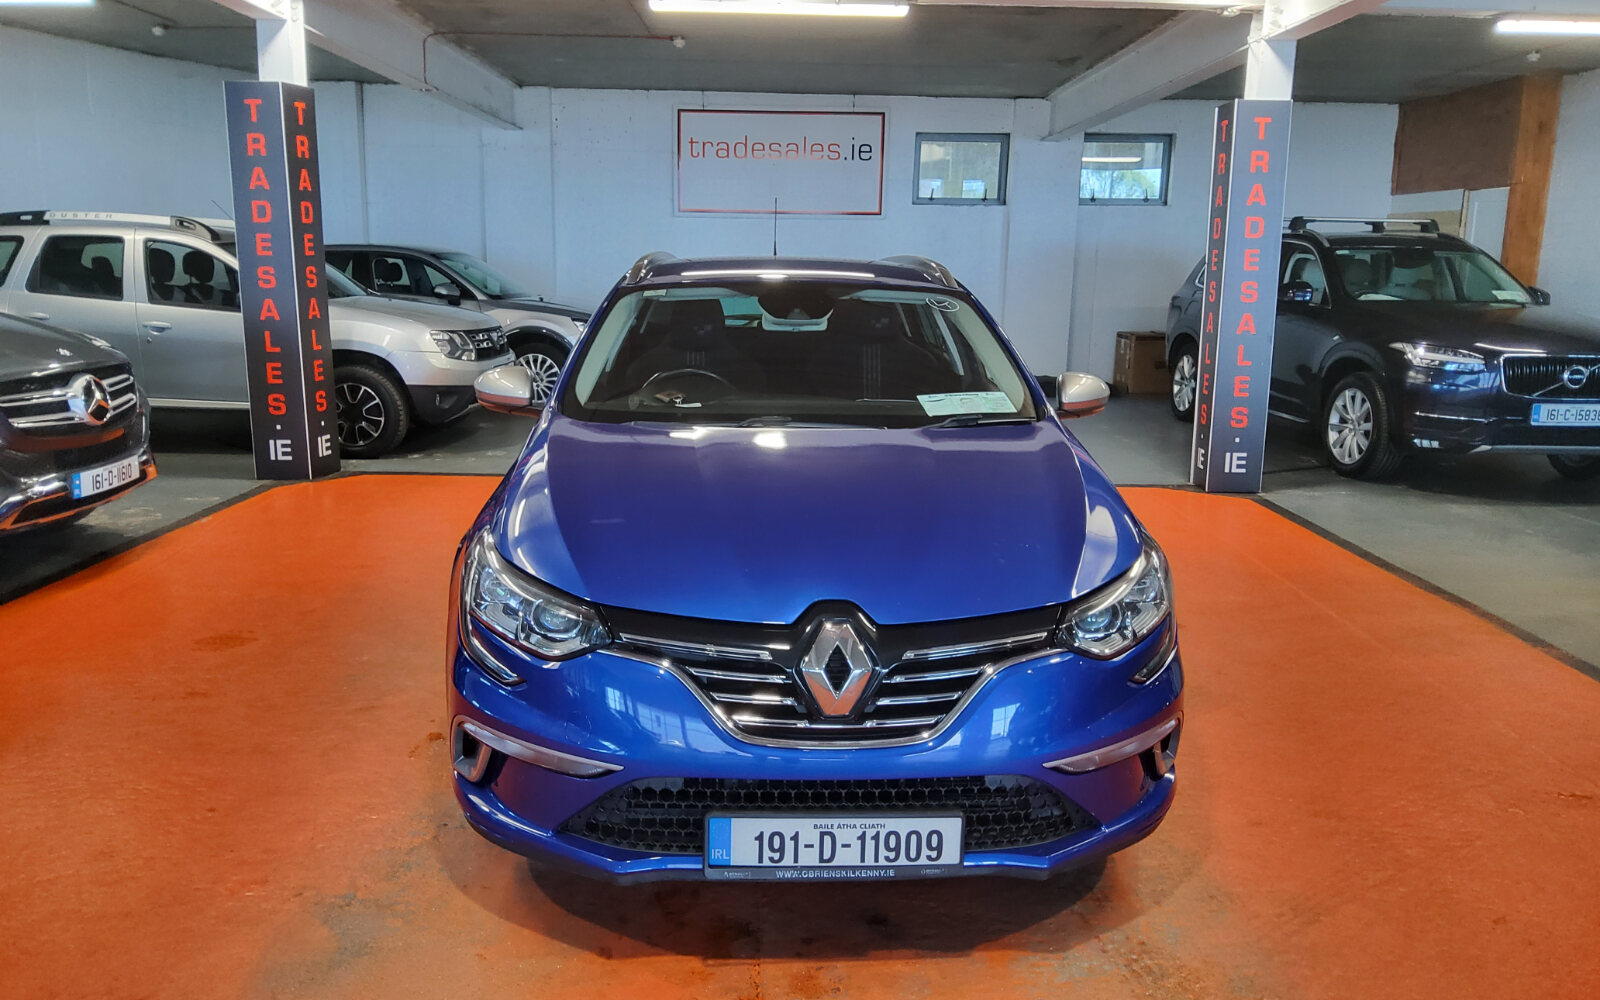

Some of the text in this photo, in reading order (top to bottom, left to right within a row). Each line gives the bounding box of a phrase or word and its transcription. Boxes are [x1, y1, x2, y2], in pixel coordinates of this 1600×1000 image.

[688, 135, 873, 161] tradesales.ie
[91, 463, 133, 492] 161-D-11610
[711, 829, 944, 865] IRL 191-D-11909
